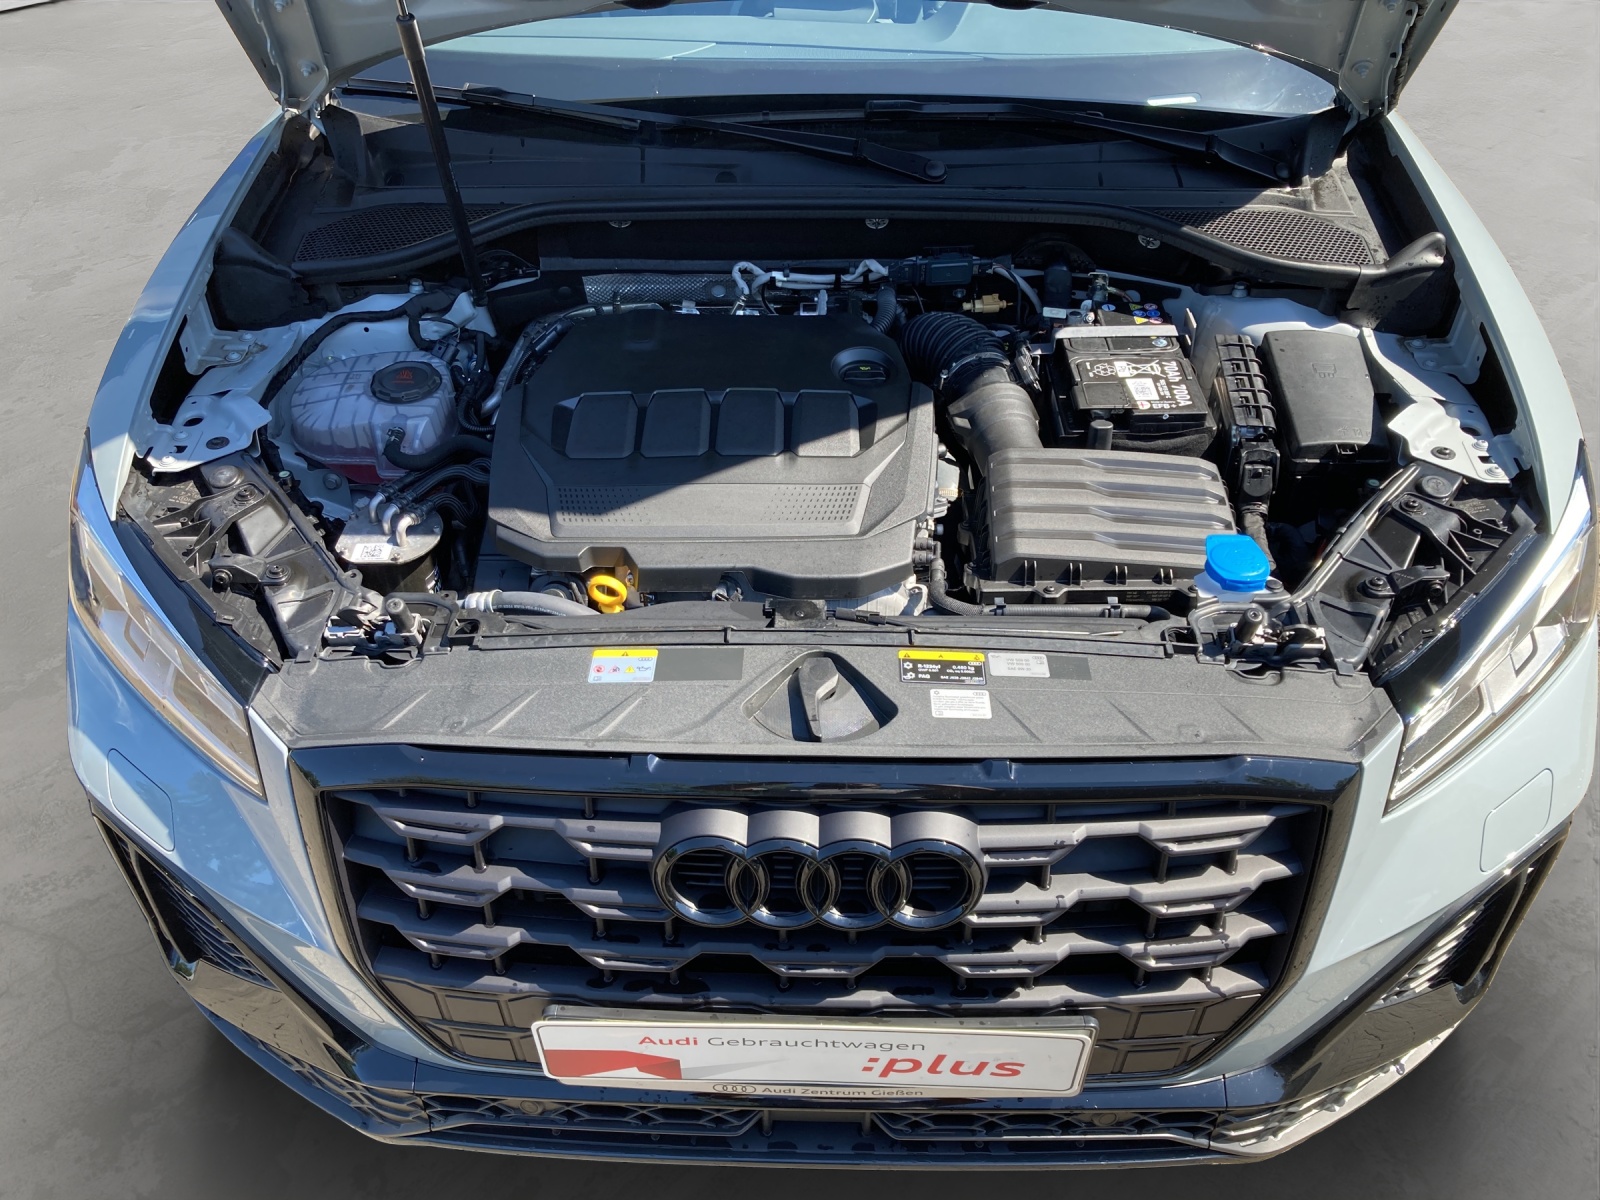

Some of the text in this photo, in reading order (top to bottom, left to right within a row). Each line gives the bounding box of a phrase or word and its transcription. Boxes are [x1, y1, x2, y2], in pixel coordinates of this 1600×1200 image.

[1161, 361, 1183, 382] 70Ah
[1171, 384, 1193, 406] 700A
[638, 1036, 926, 1052] Audi Gebrauchtwagen
[762, 1086, 924, 1096] Audi Zentrum Gießen
